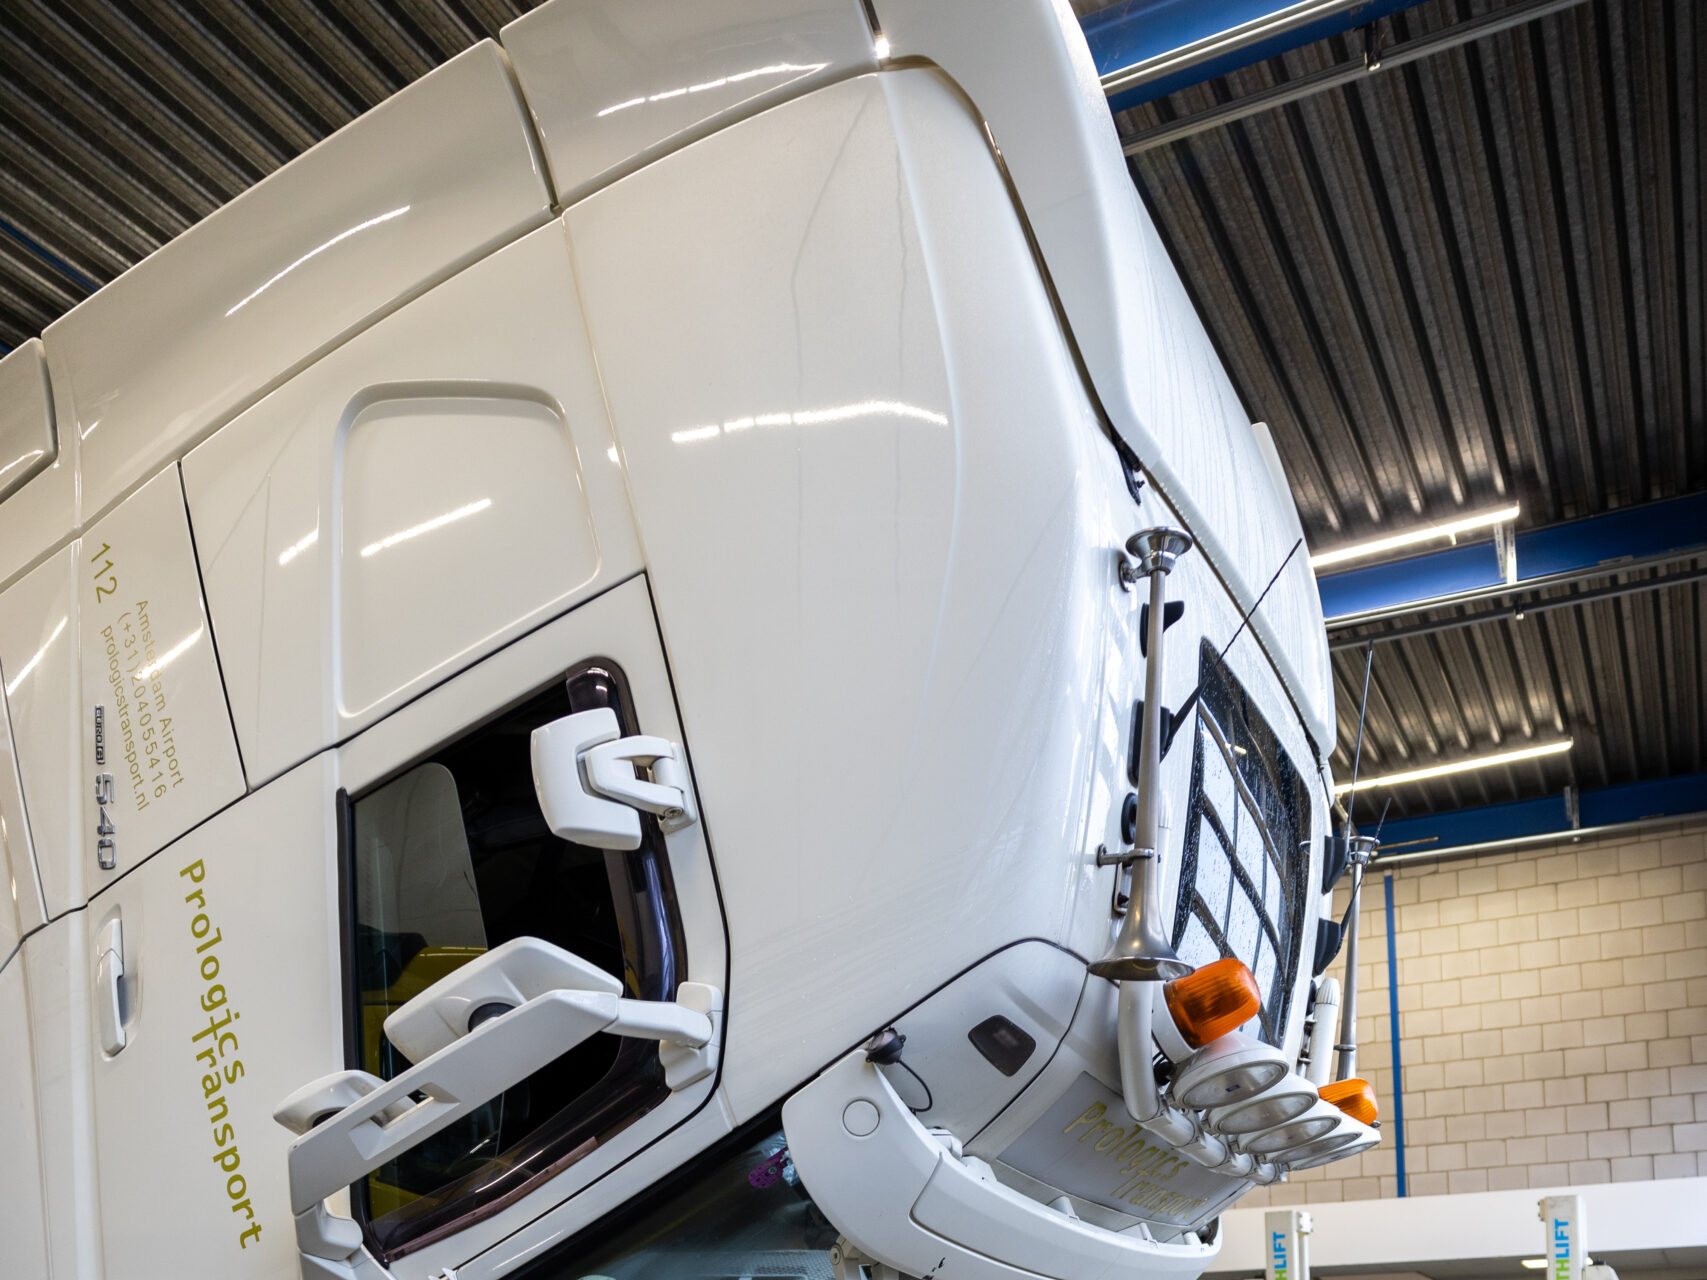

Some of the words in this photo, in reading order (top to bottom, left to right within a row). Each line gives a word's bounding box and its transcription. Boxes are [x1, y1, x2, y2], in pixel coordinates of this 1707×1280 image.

[90, 542, 118, 604] 112
[100, 624, 150, 812] prologicstransport.nl
[136, 600, 167, 712] Amsterdam
[159, 716, 185, 789] Airport
[96, 772, 117, 870] 540
[179, 858, 247, 1086] Prologics
[191, 1014, 262, 1250] Transport
[1063, 1101, 1190, 1182] Prologics
[1110, 1169, 1209, 1219] Transport
